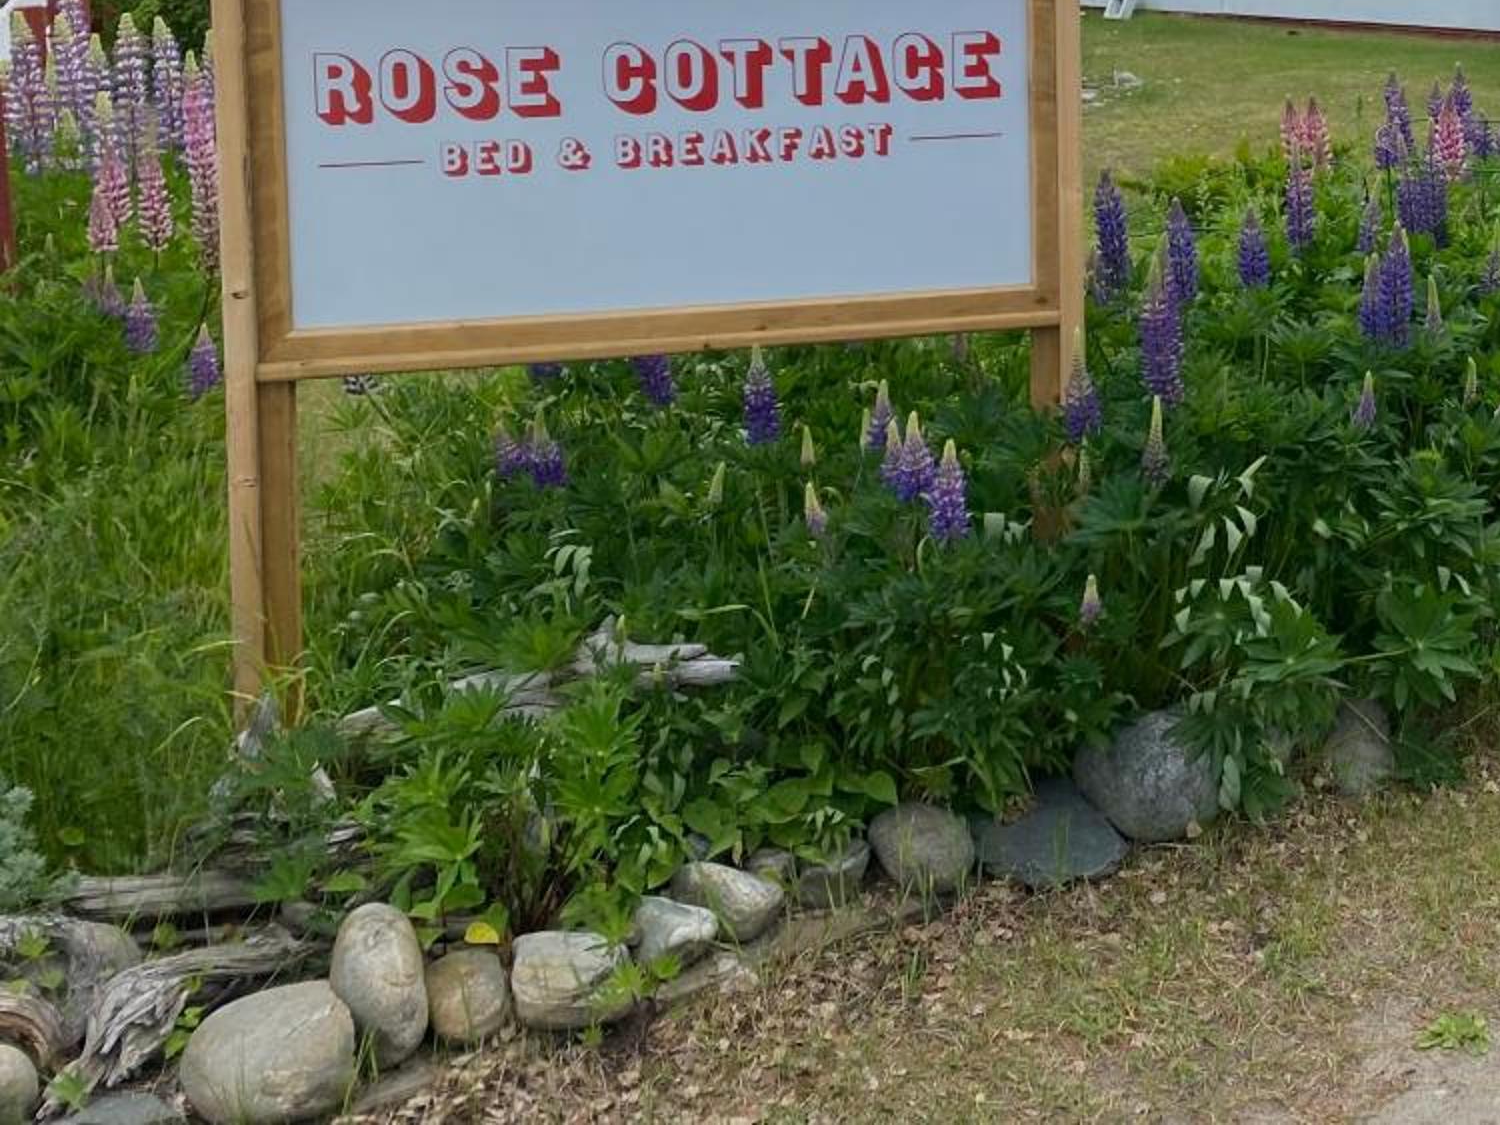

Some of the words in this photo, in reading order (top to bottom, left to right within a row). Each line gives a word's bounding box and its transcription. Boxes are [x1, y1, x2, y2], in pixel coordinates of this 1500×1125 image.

[313, 46, 561, 125] ROSE
[601, 31, 1001, 115] COTTAGE
[441, 140, 532, 177] BED
[558, 137, 592, 170] &
[614, 123, 894, 169] BREAKFAST
